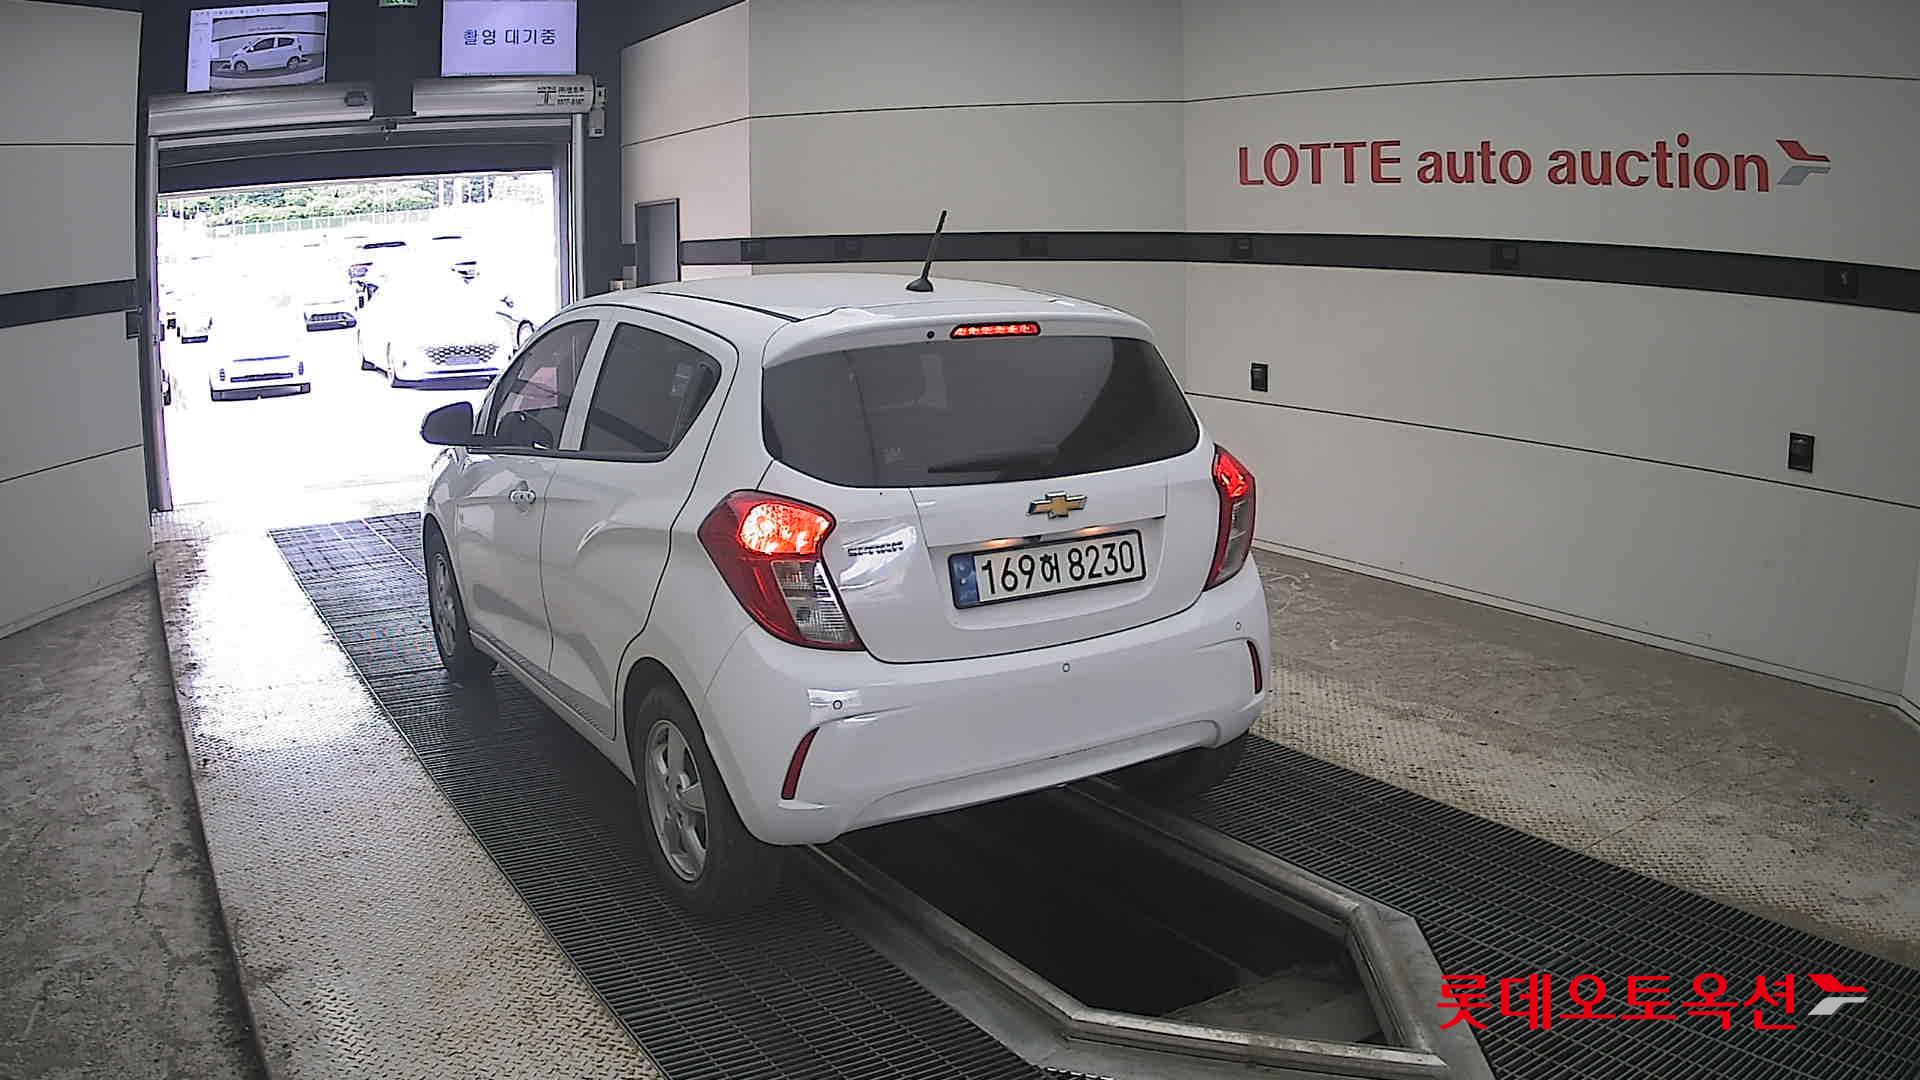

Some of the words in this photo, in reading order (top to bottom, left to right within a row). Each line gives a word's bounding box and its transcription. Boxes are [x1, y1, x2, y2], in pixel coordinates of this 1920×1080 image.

[504, 28, 557, 46] 대기중
[1239, 140, 1400, 187] LOTTE
[1416, 141, 1532, 185] auto
[1547, 133, 1770, 192] auction
